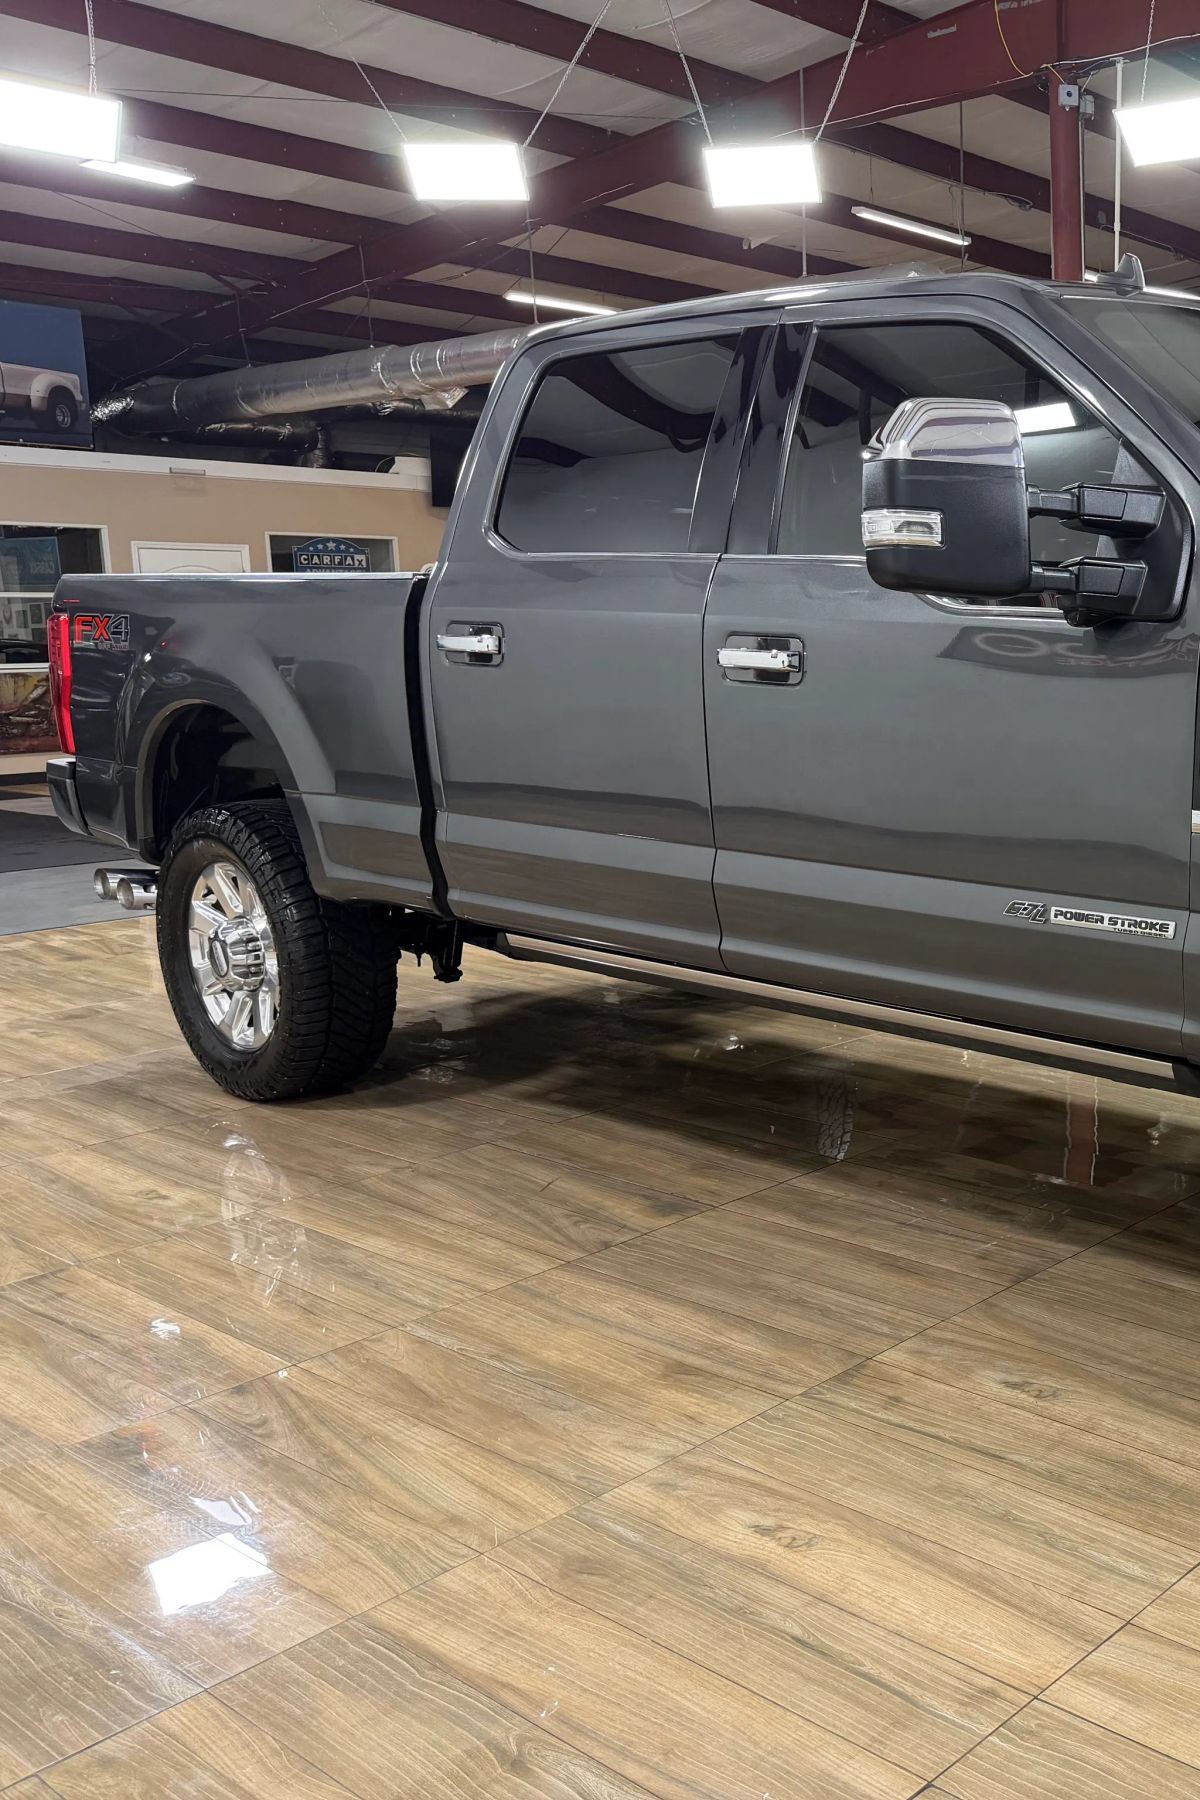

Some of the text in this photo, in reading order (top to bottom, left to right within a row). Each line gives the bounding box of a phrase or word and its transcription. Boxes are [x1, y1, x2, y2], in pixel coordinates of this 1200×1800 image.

[300, 554, 364, 568] CARFAX
[74, 613, 130, 643] FX4
[1053, 908, 1104, 925] POWER
[1107, 916, 1170, 933] STROKE
